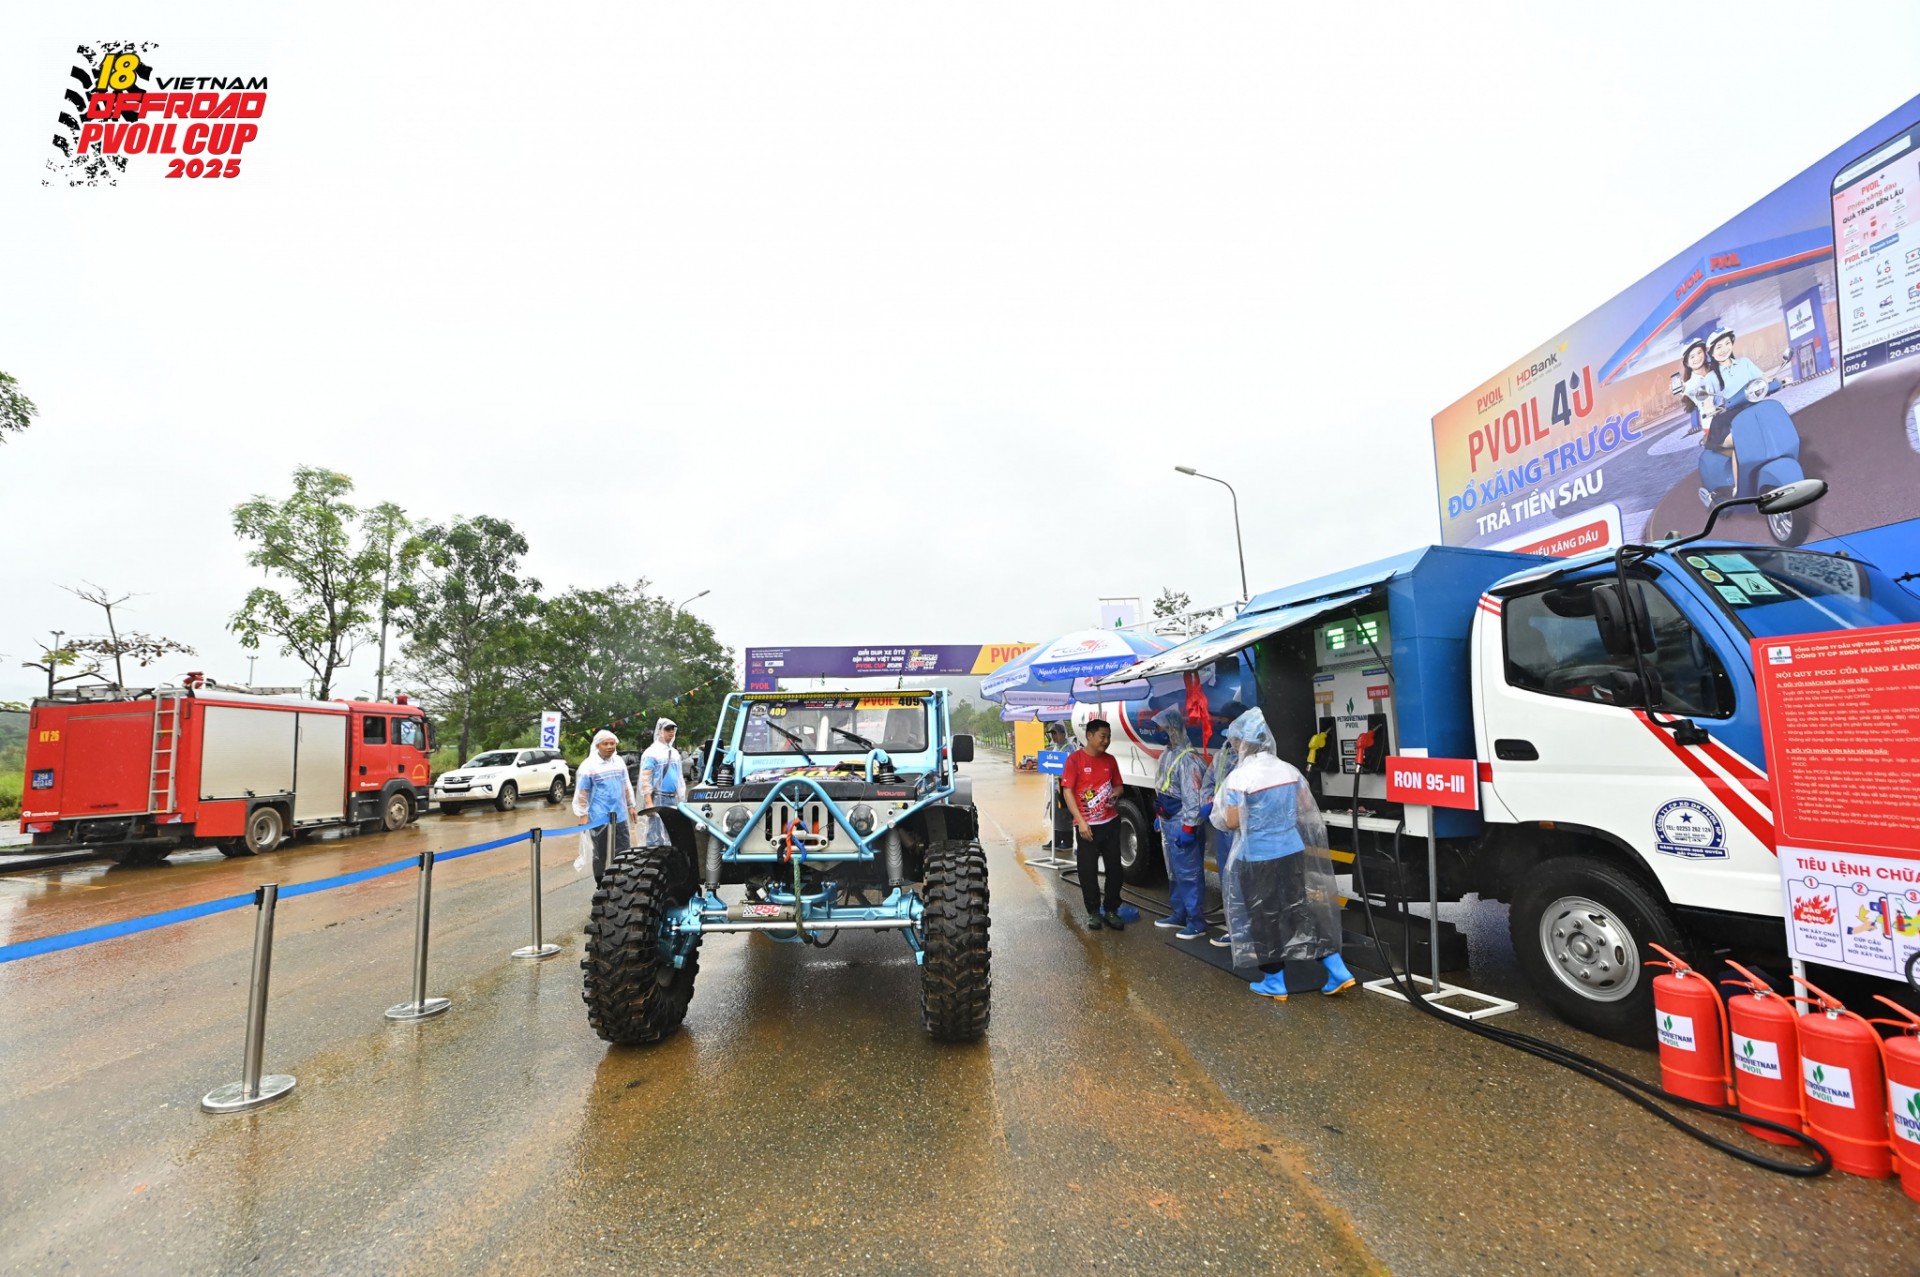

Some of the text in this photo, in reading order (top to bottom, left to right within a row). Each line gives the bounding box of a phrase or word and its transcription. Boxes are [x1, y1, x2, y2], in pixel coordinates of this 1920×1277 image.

[1517, 353, 1558, 386] HDBank
[1477, 387, 1503, 414] PVOIL
[1447, 410, 1644, 518] ĐỔ XĂNG TRƯỚC
[1476, 469, 1604, 536] TRẢ TIỀN SAU
[1551, 538, 1576, 554] XĂNG
[1775, 671, 1792, 679] NỘI
[1839, 666, 1859, 674] CỦA
[1860, 665, 1889, 673] HÀNG
[1891, 663, 1920, 672] XĂNG
[751, 682, 769, 690] PVOIL
[863, 696, 894, 706] PVOIL
[898, 696, 920, 706] 409
[769, 707, 787, 716] 409
[1337, 714, 1368, 722] PETROVIETNAM
[40, 730, 60, 742] KV 26
[544, 725, 556, 749] ISA
[1394, 770, 1465, 793] RON 95-III
[693, 790, 734, 800] UNICLUTCH
[1796, 857, 1827, 872] TIÊU
[1832, 860, 1871, 877] LỆNH
[1808, 878, 1814, 887] 1
[1857, 884, 1864, 893] 2
[1909, 891, 1918, 901] 3
[754, 904, 780, 914] PSC
[1663, 1037, 1679, 1047] PVOIL
[1735, 1053, 1777, 1070] ETROVIETNAM
[1743, 1063, 1762, 1074] PVOIL
[1812, 1090, 1833, 1102] PVOIL
